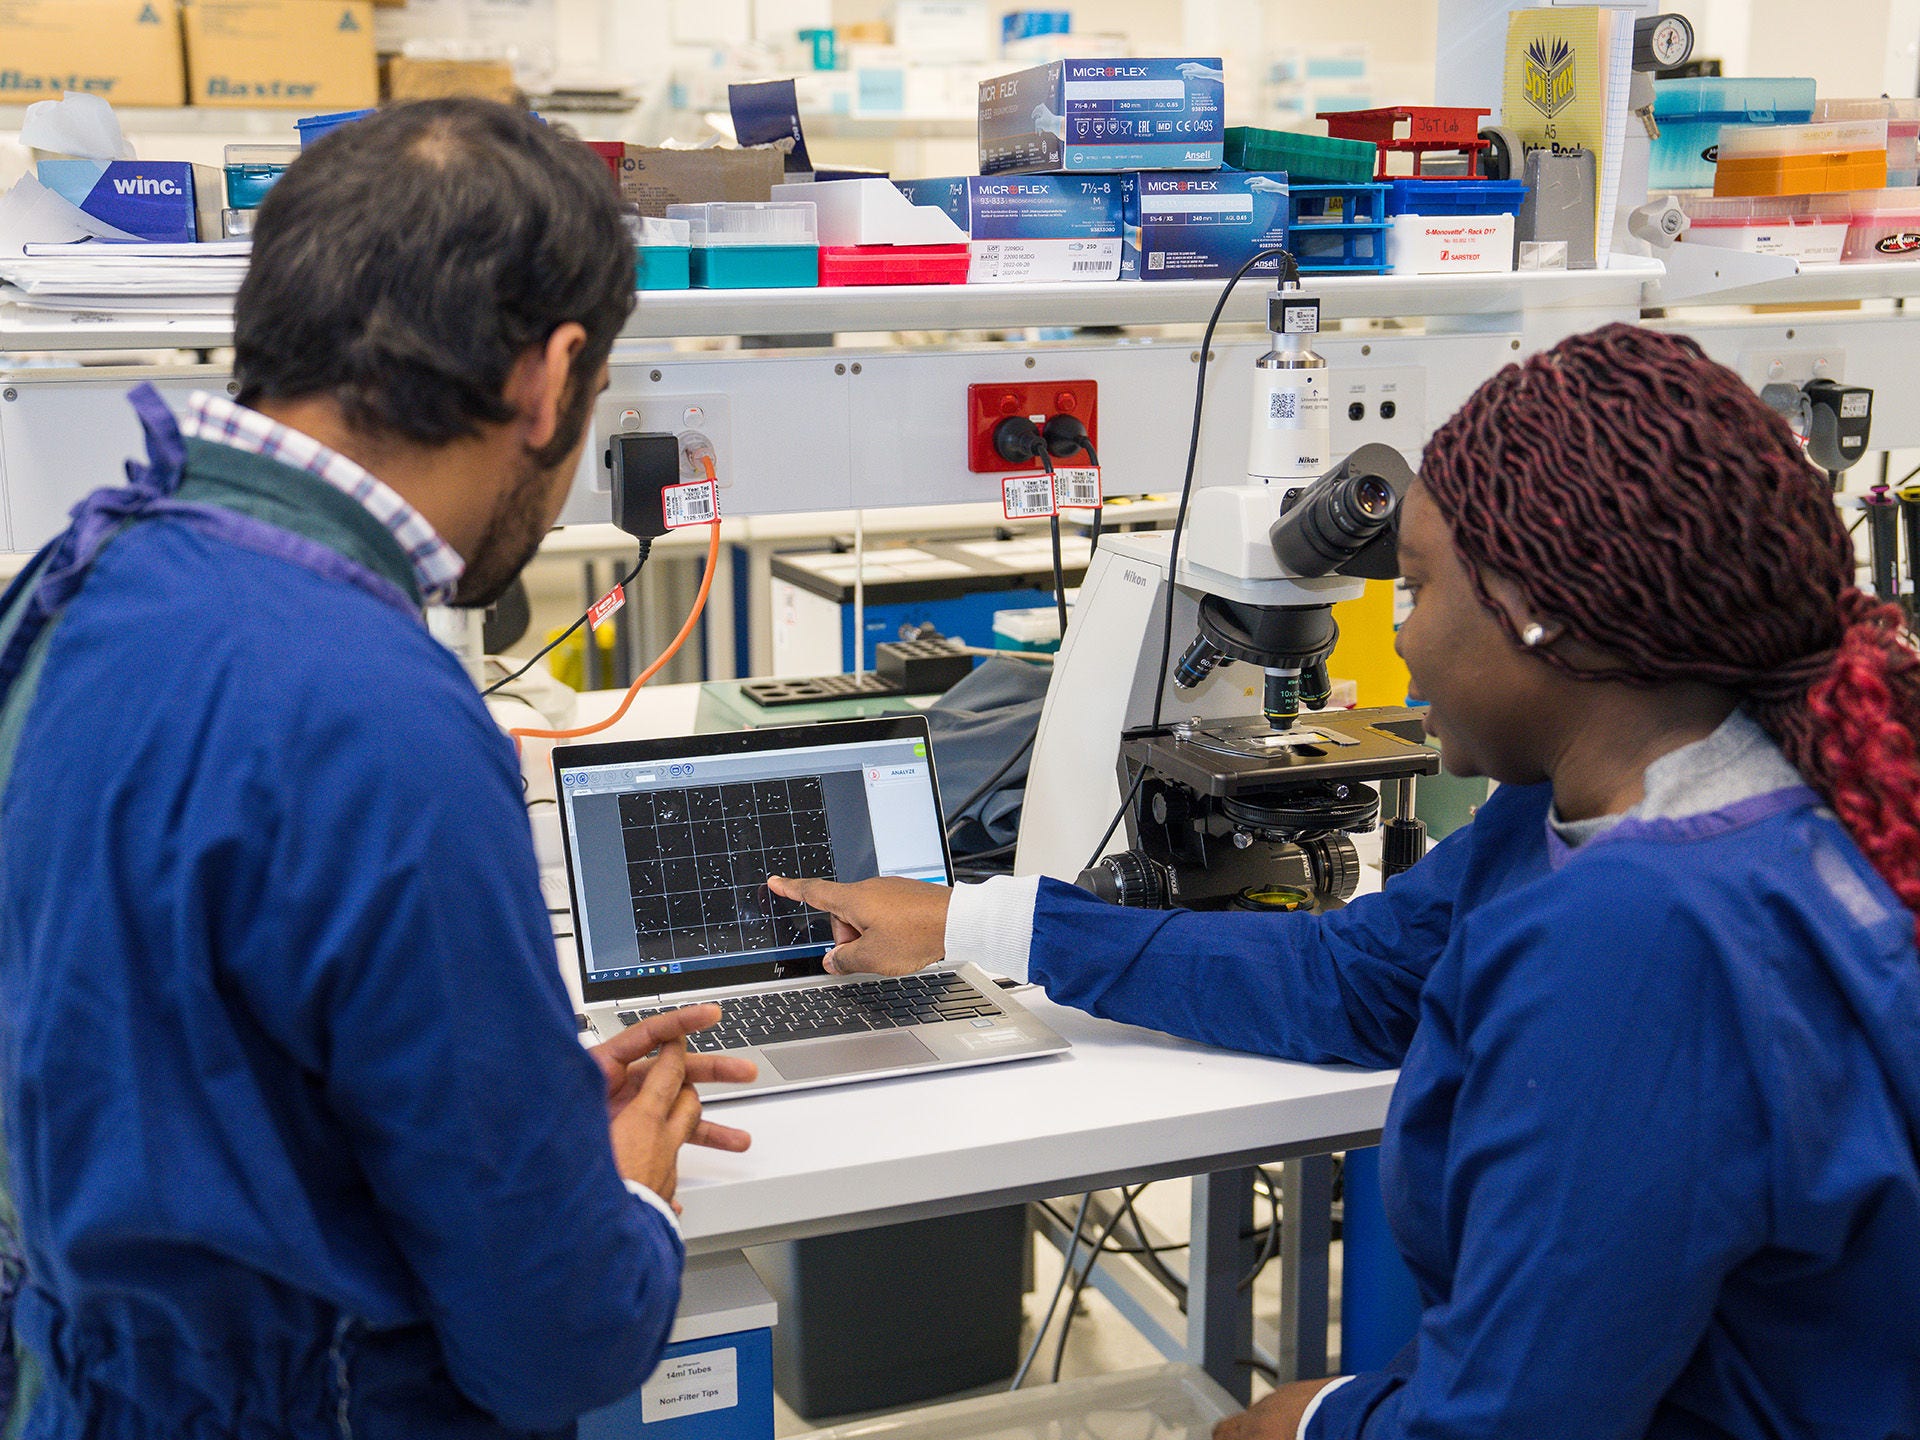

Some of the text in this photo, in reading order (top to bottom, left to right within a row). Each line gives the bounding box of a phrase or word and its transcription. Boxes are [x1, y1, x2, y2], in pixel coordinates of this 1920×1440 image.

[1073, 67, 1148, 78] MICROFLEX
[207, 76, 318, 101] Baxter
[1158, 122, 1171, 130] MD
[1193, 120, 1213, 132] 0493
[1443, 121, 1459, 134] Lab
[1545, 123, 1557, 139] A5
[1185, 150, 1212, 161] Ansell
[113, 175, 182, 195] winc.
[980, 185, 1049, 195] MICROFLEX
[1148, 181, 1218, 191] MICROFLEX
[1123, 569, 1147, 587] Nikon
[891, 769, 915, 777] ANALYZE
[667, 1366, 712, 1379] 14ml Tubes
[659, 1389, 719, 1405] Non-Filter Tips
